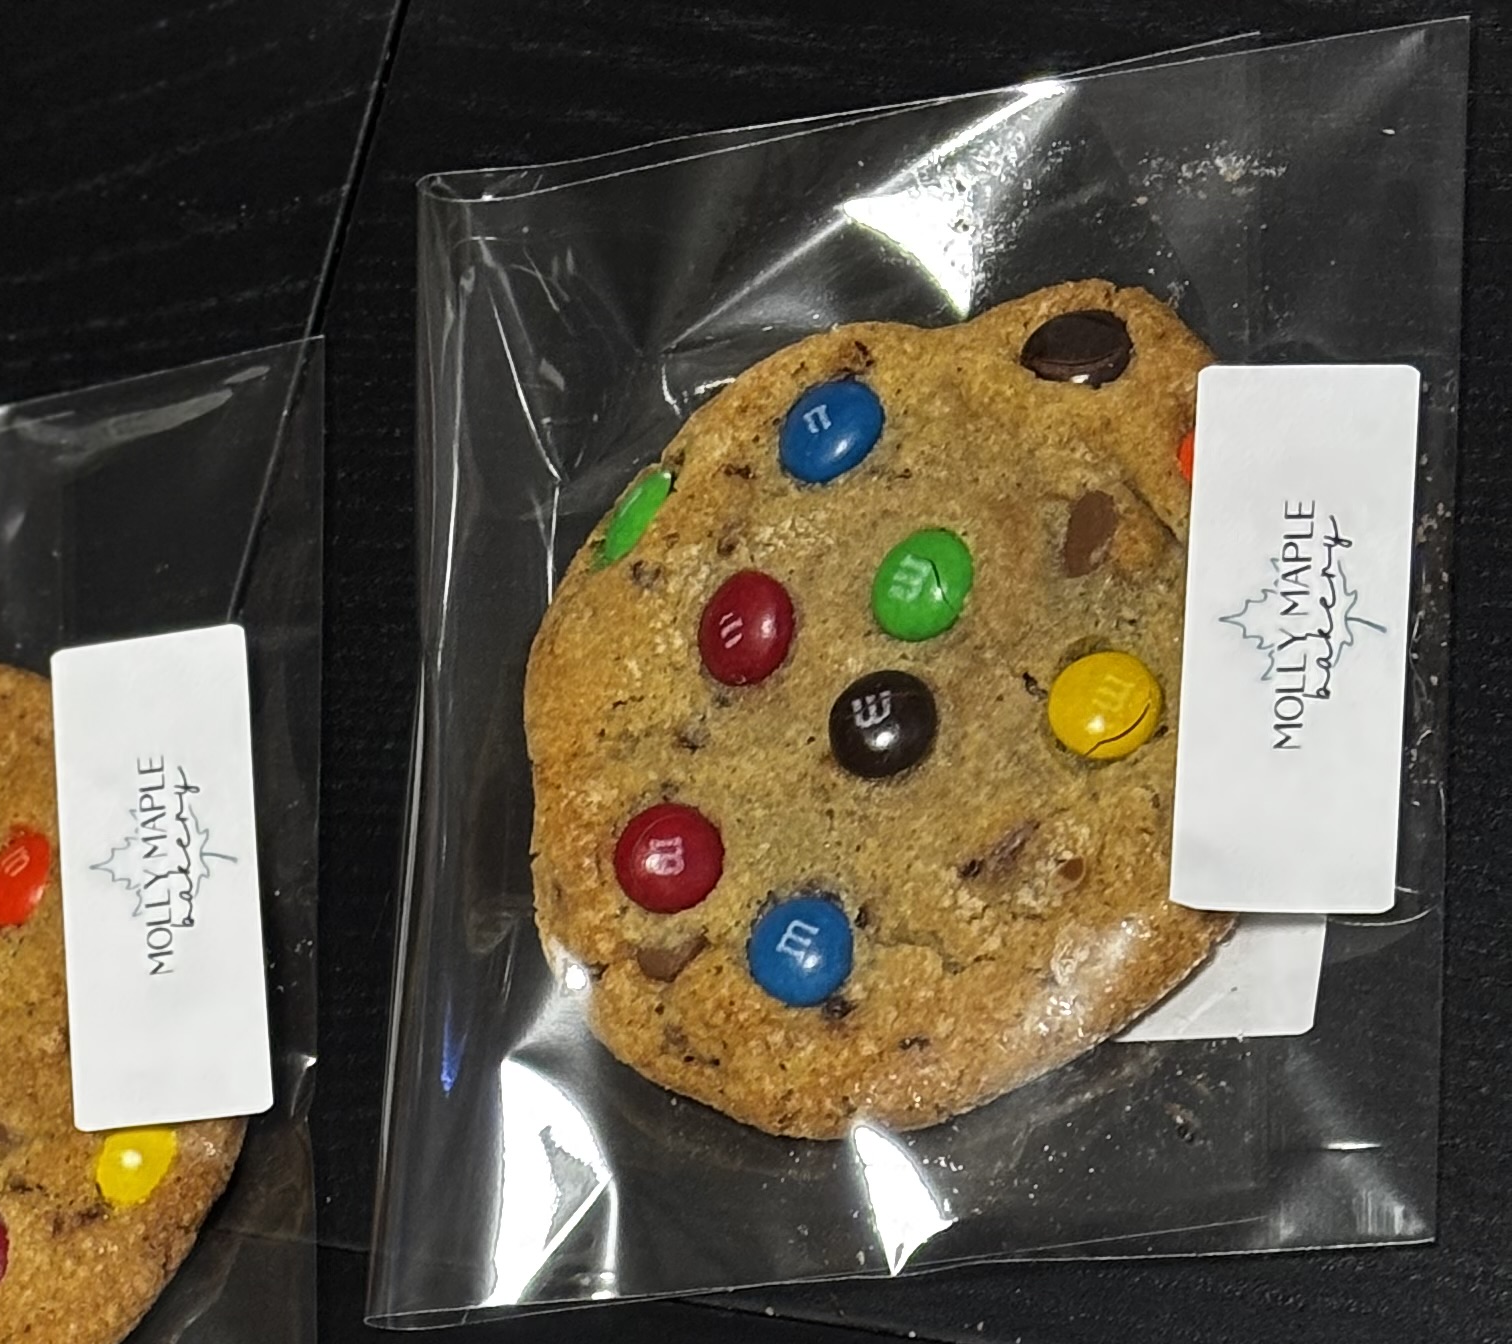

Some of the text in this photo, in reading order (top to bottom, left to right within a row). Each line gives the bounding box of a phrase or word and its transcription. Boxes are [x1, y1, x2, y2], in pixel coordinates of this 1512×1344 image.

[1273, 500, 1315, 749] MOLLY MAPLE
[1302, 514, 1353, 699] bakery
[852, 689, 891, 728] m
[137, 754, 174, 975] MOLLY MAPLE
[168, 766, 200, 928] bakery
[776, 920, 819, 962] m
